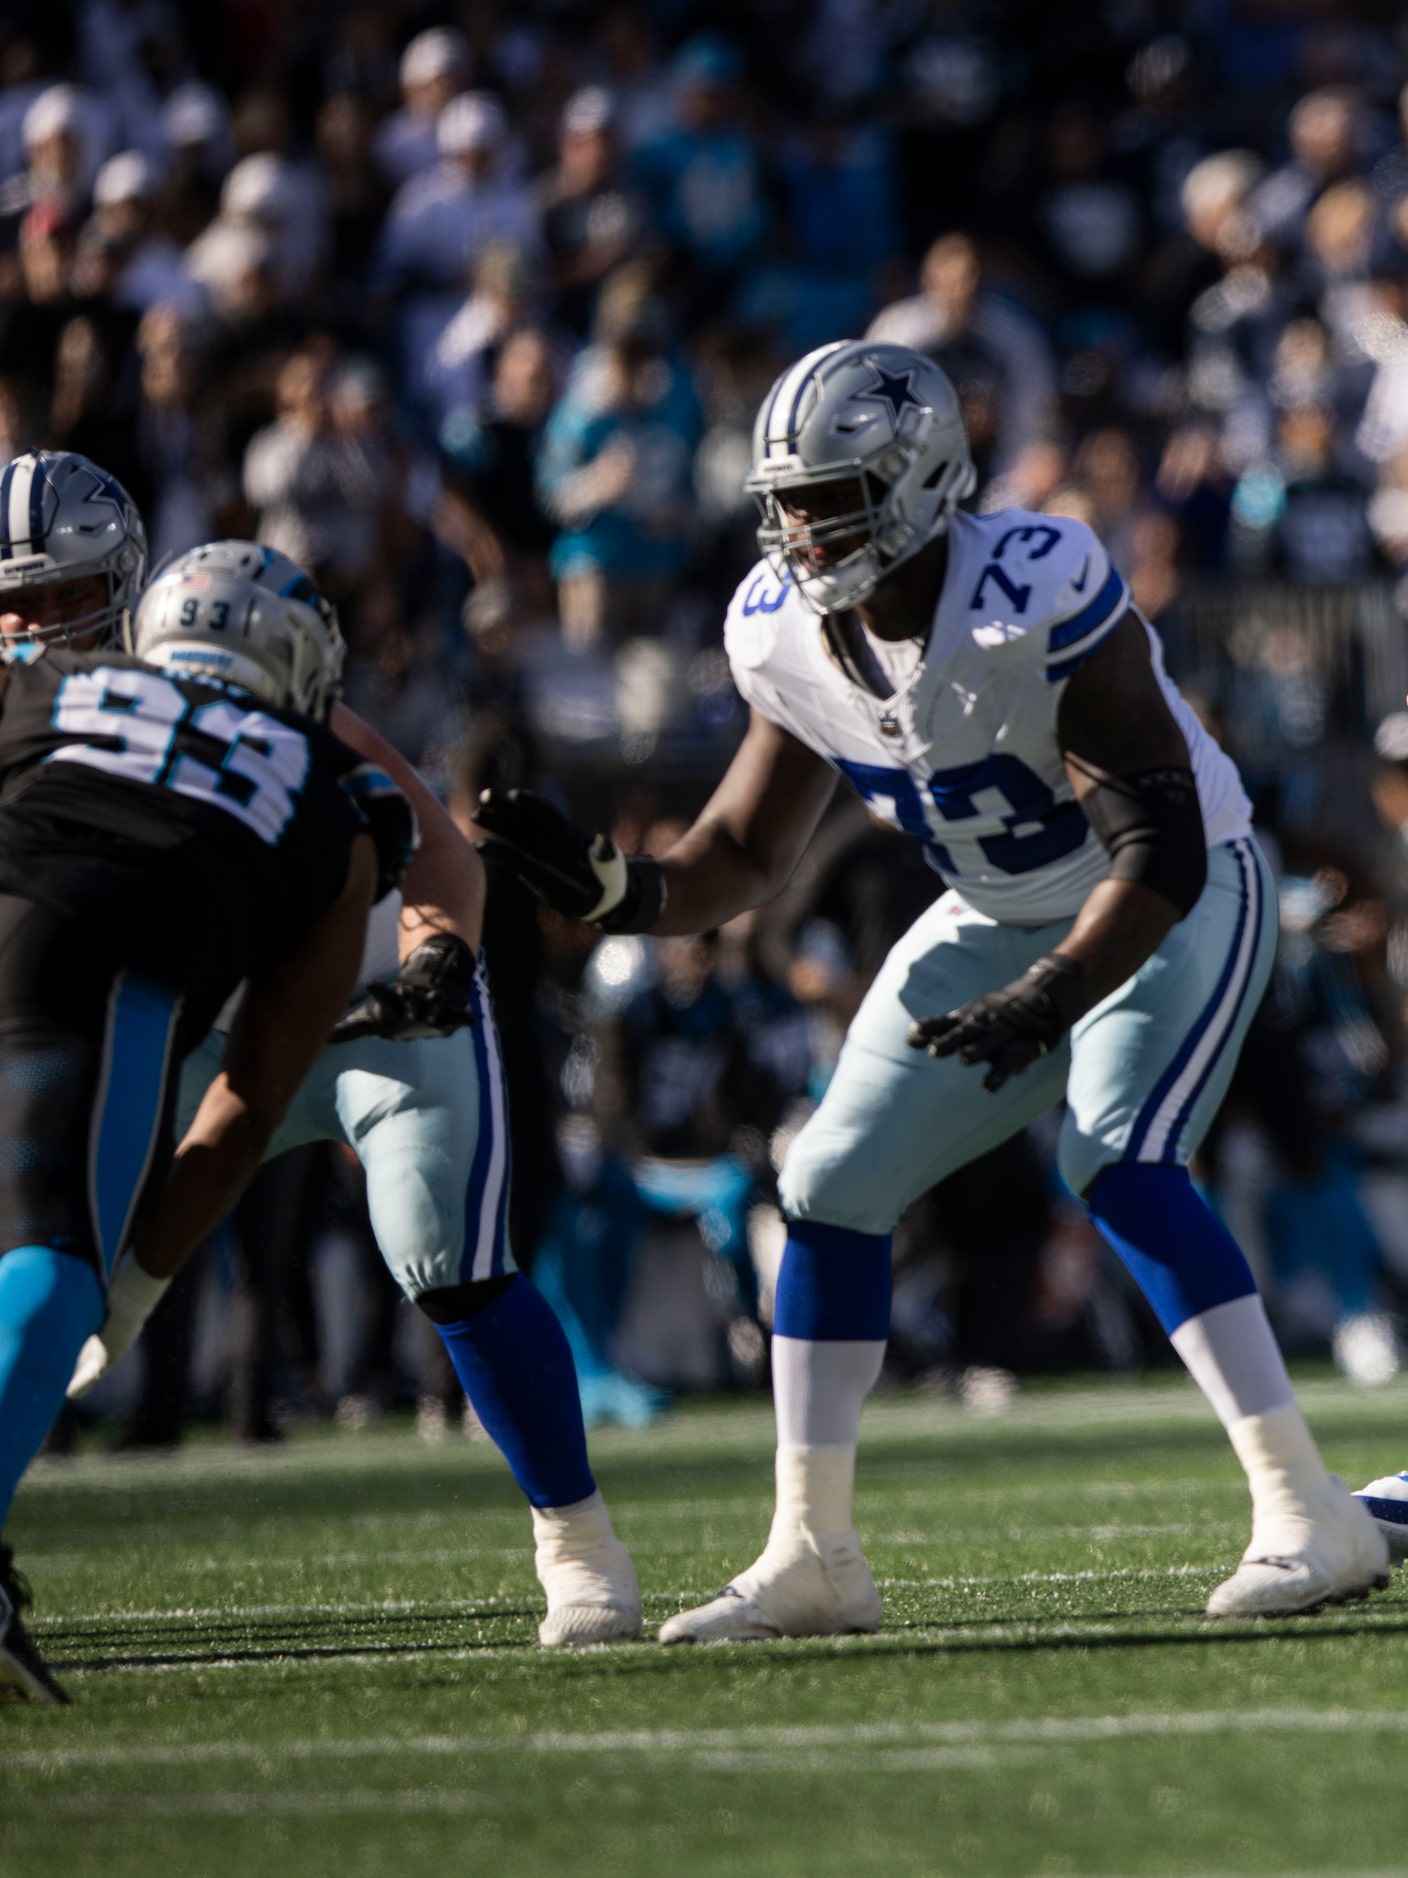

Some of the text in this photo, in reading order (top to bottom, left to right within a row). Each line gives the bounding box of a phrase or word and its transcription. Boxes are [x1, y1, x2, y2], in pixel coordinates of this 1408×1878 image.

[180, 598, 231, 631] 93
[970, 524, 1062, 613] 73
[41, 666, 310, 848] 93
[832, 753, 1090, 876] 73
